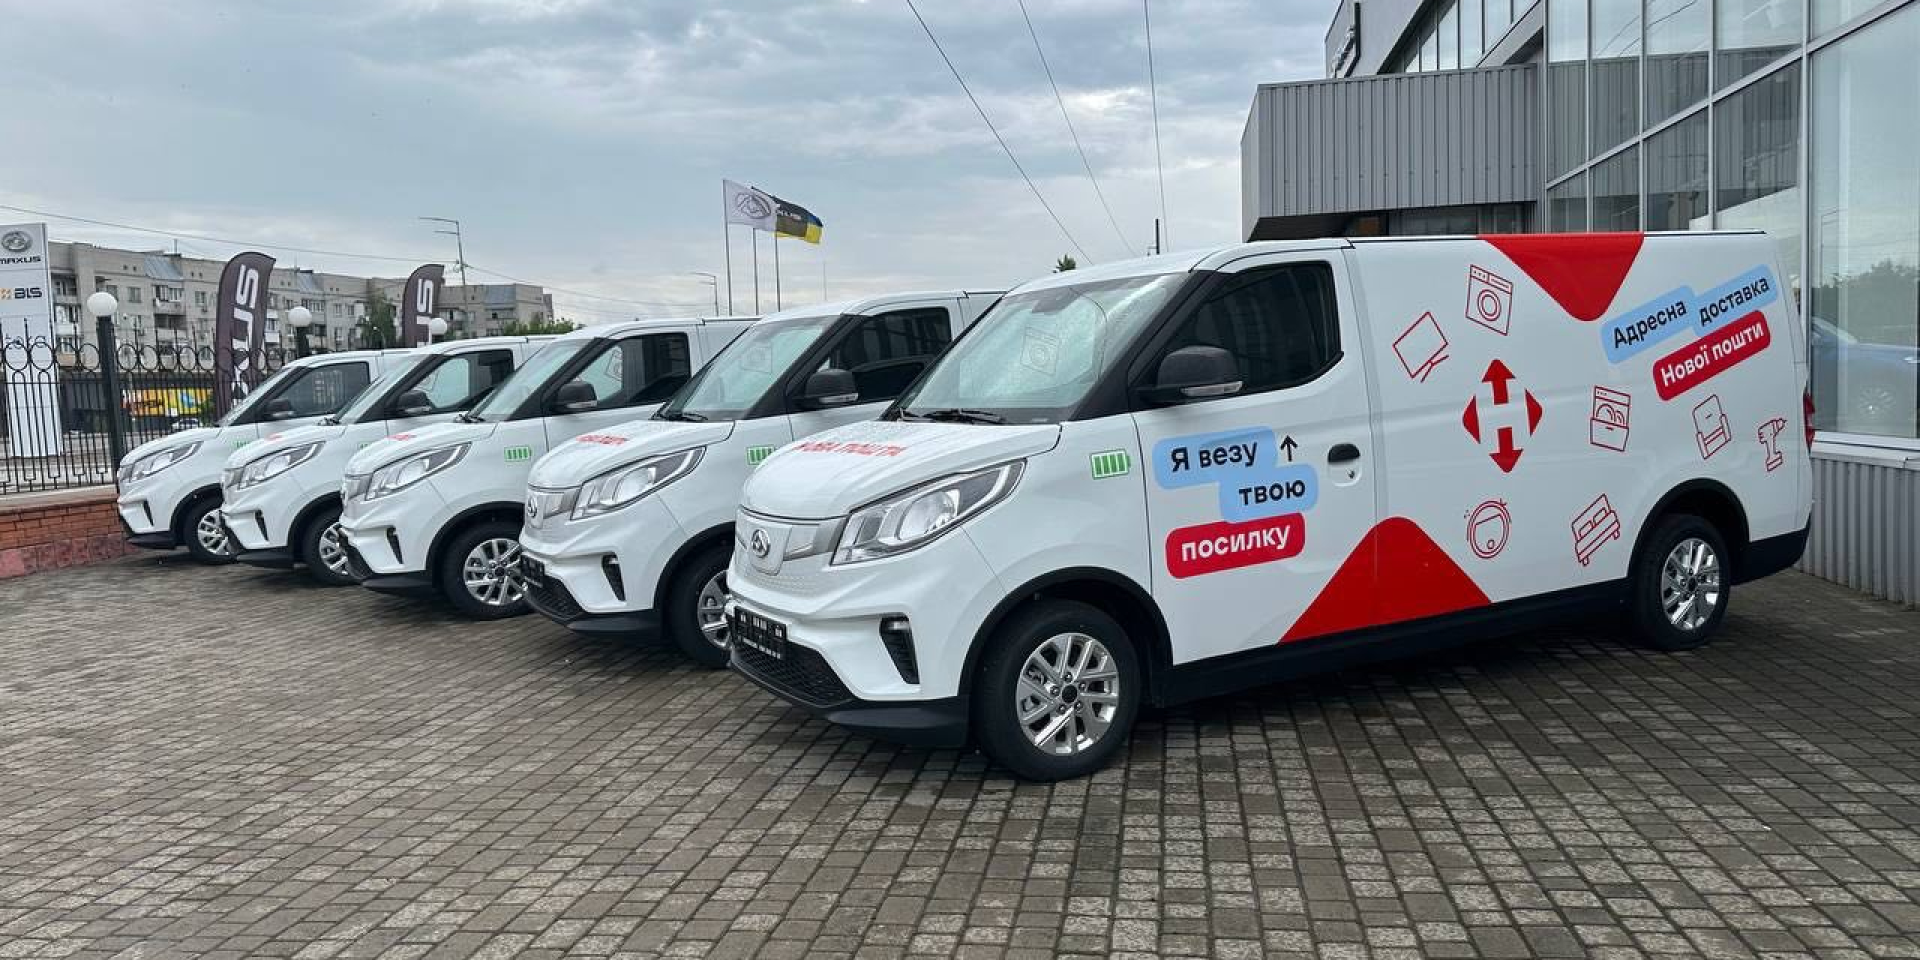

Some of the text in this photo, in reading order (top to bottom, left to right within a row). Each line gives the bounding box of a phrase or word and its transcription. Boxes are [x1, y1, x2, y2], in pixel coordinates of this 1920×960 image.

[1613, 277, 1770, 348] Адресна доставка
[1660, 321, 1764, 386] Нової пошти
[1171, 442, 1257, 472] Я везу
[1239, 480, 1306, 505] твою
[1181, 525, 1290, 562] посилку
